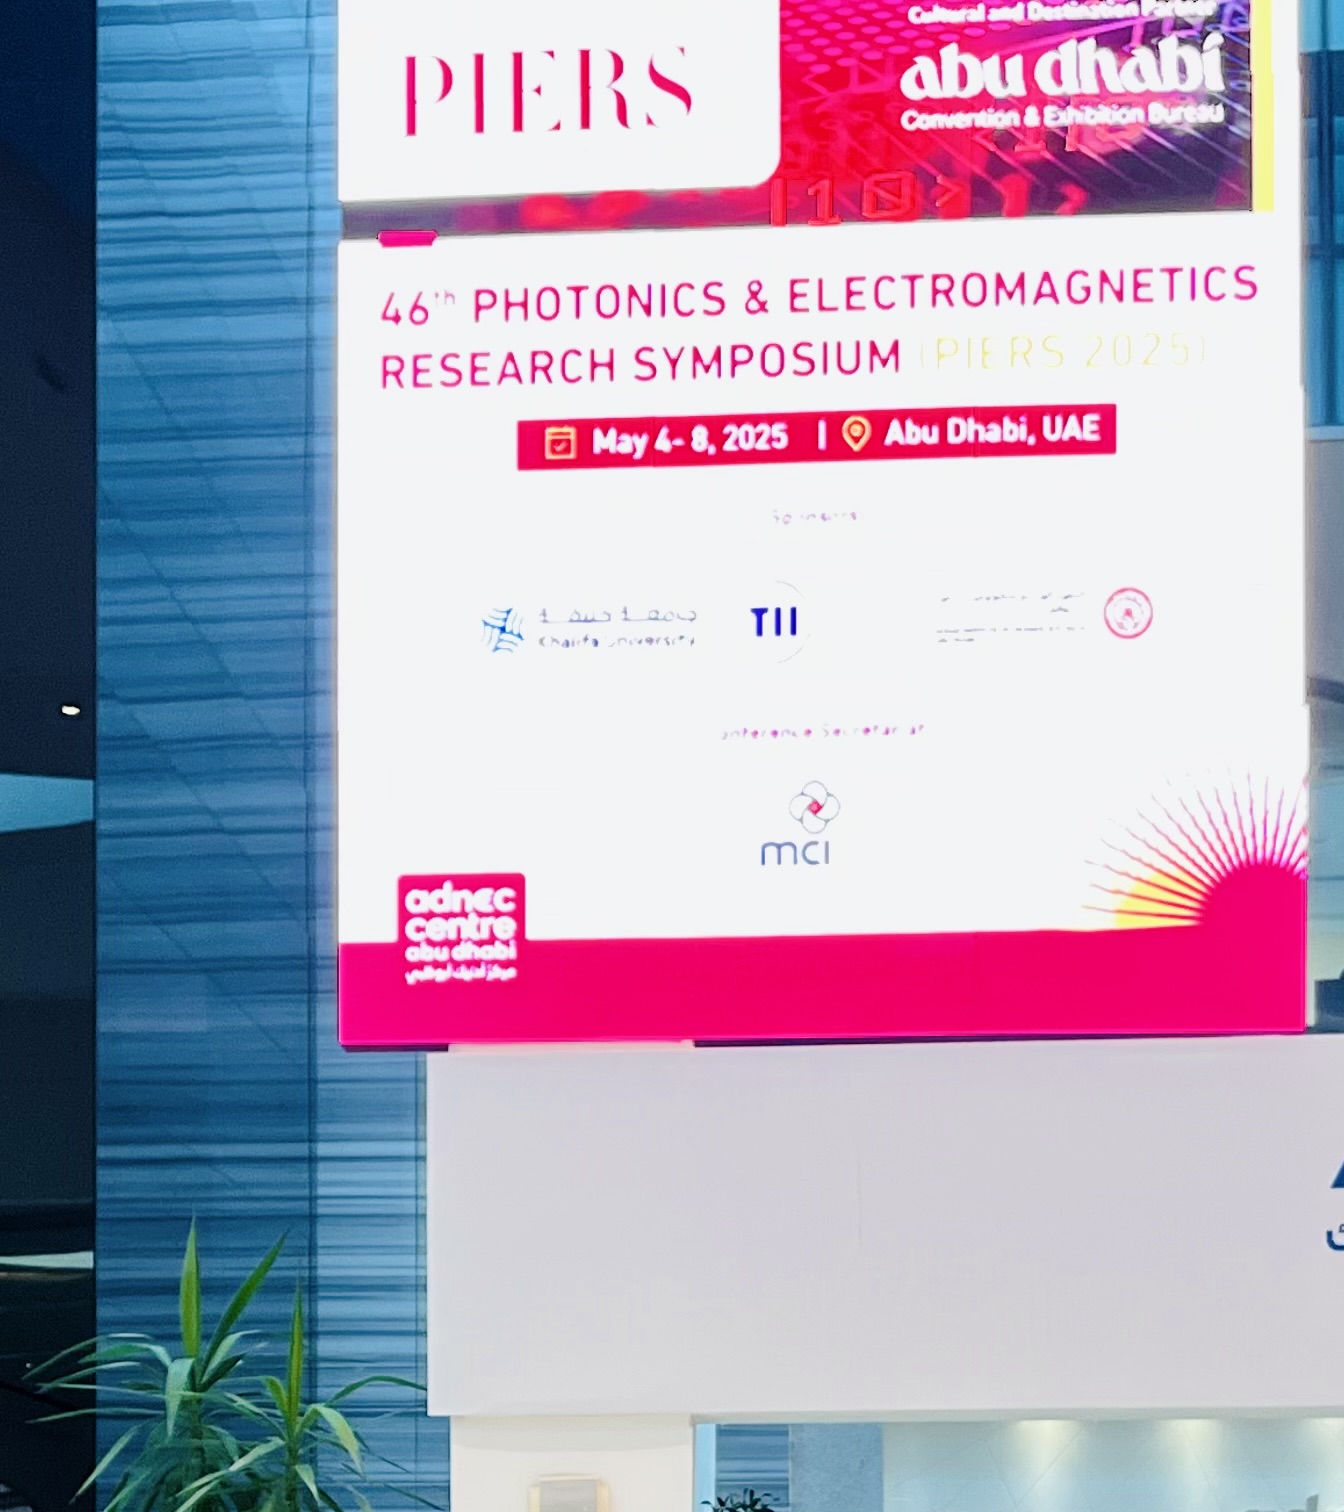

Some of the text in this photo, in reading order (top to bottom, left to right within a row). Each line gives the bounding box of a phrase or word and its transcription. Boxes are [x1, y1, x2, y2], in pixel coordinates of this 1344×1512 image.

[988, 2, 1024, 22] and
[900, 43, 1027, 100] abu
[404, 46, 692, 137] PIERS
[900, 102, 1225, 131] Convention & Exhibition Bureau
[473, 281, 726, 324] PHOTONICS
[744, 279, 769, 316] &
[789, 265, 1258, 313] ELECTROMAGNETICS
[380, 332, 1205, 389] RESEARCH SYMPOSIUM (PIERS 2025)
[592, 427, 649, 459] May
[723, 422, 789, 452] 2025
[883, 414, 1101, 447] Abu Dhabi, UAE
[751, 606, 797, 637] TII
[760, 840, 830, 866] mci
[404, 880, 517, 914] adnec
[404, 912, 517, 942] centre
[405, 939, 517, 963] abu dhabi
